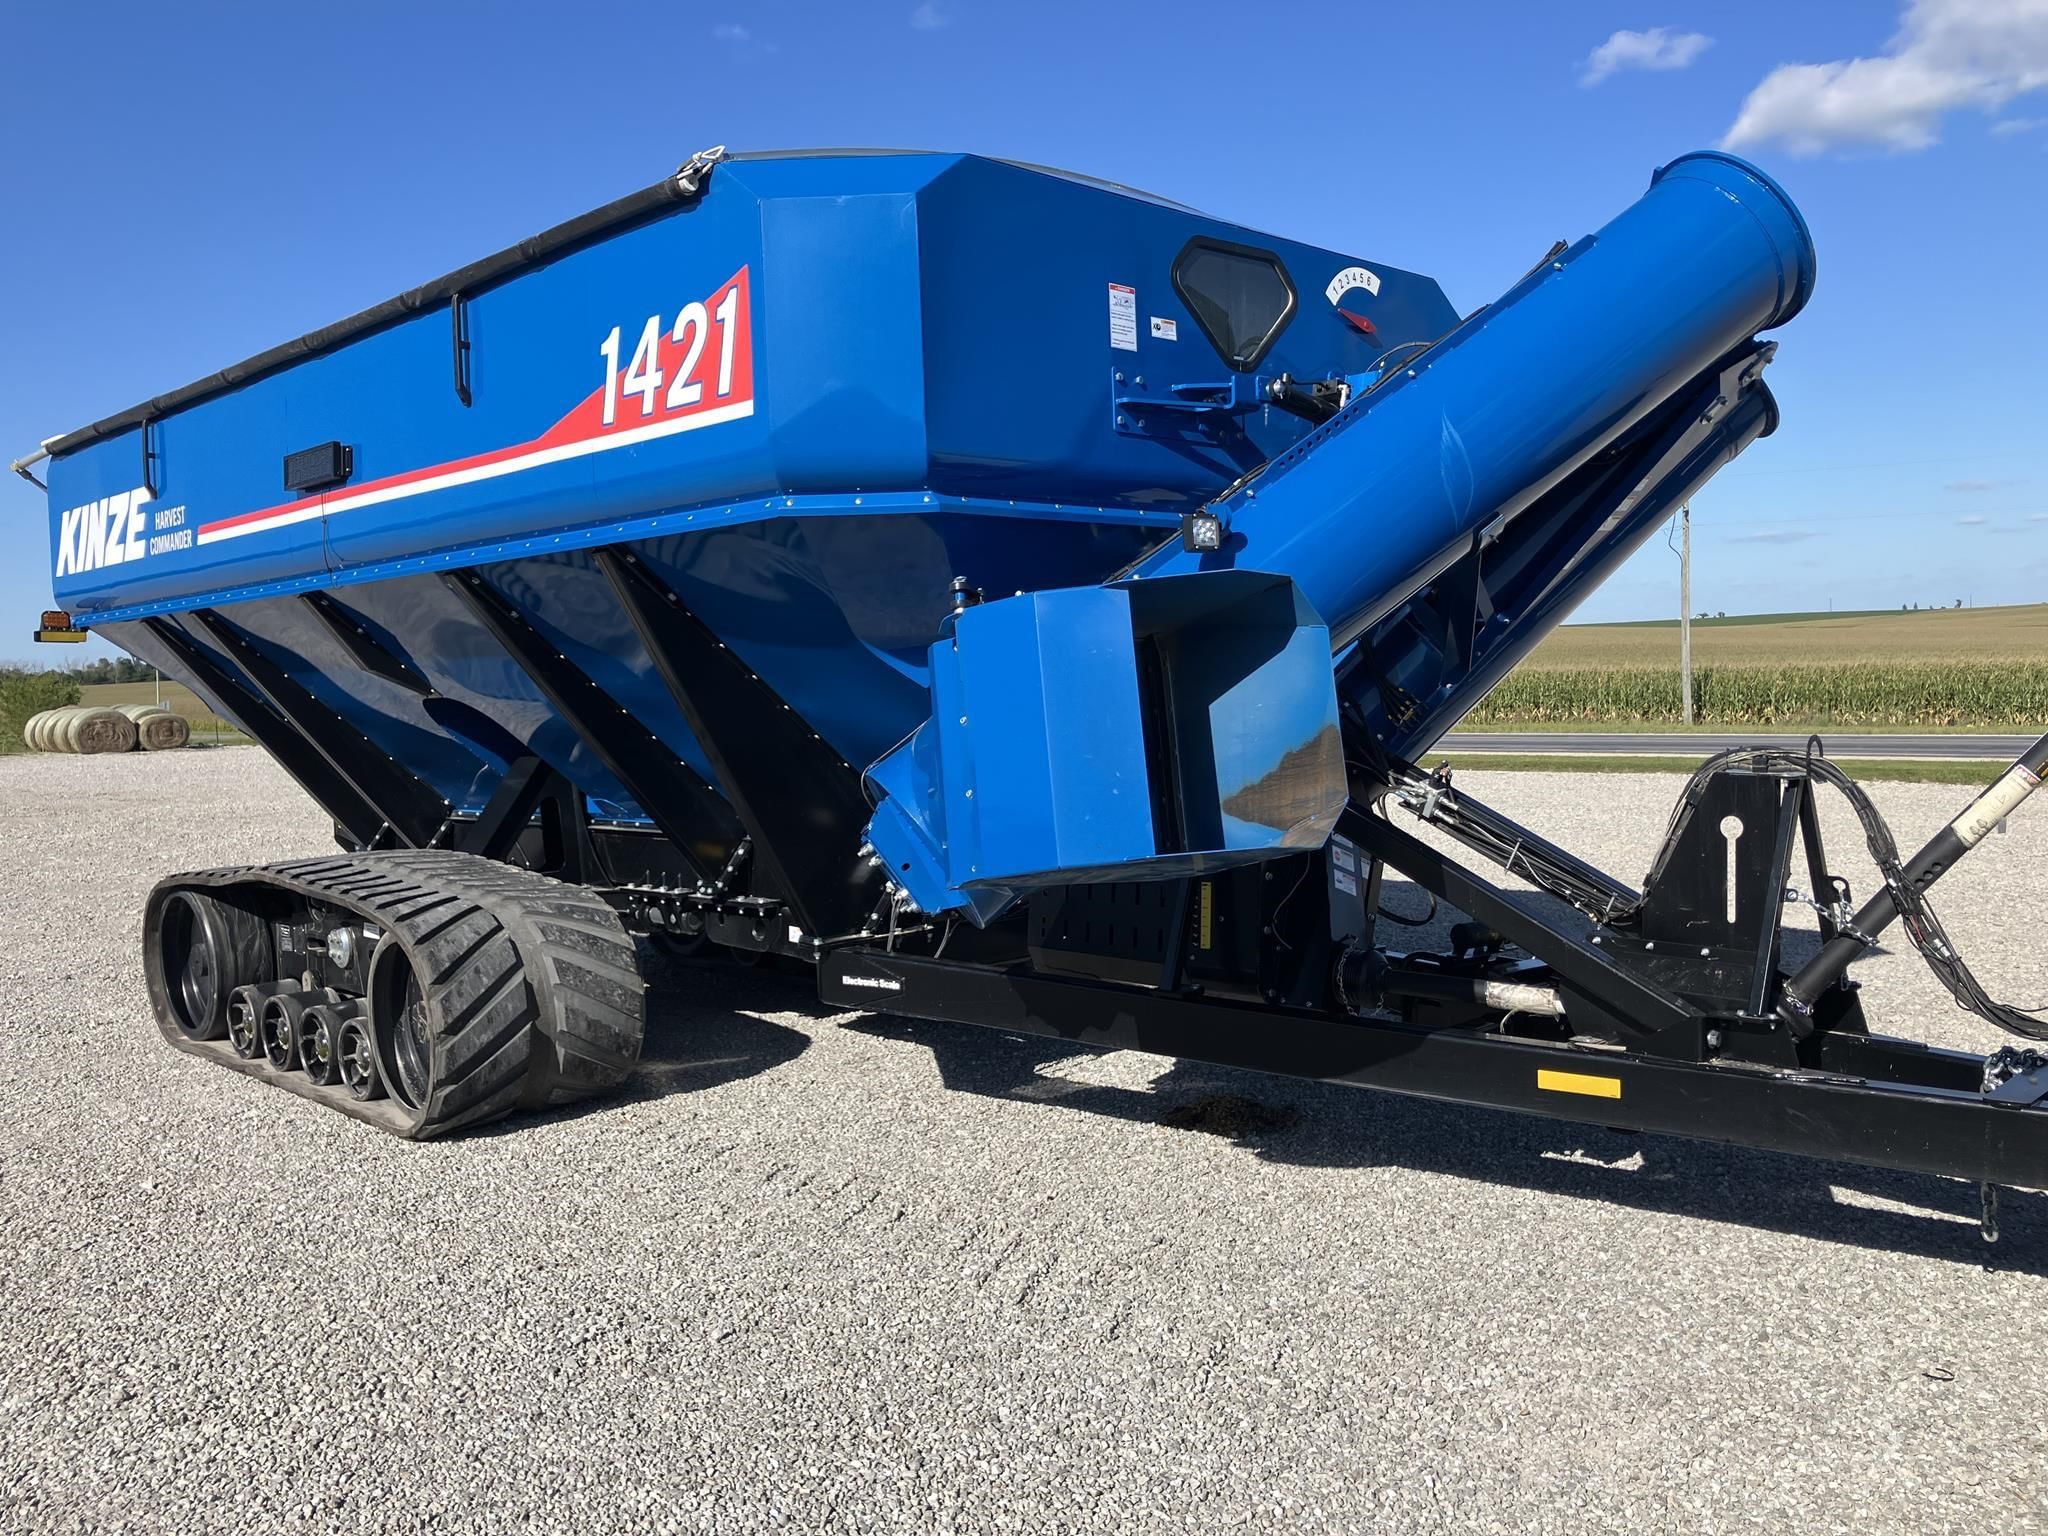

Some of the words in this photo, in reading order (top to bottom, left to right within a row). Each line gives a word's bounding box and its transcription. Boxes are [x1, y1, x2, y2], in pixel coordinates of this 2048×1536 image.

[1332, 285, 1339, 295] 1
[1338, 278, 1344, 290] 2
[1344, 273, 1350, 285] 3
[1352, 272, 1357, 282] 4
[1359, 272, 1364, 284] 5
[1366, 276, 1372, 287] 6
[600, 287, 738, 424] 1421
[155, 505, 186, 530] HARVEST
[56, 486, 152, 577] KINZE
[149, 529, 193, 556] COMMANDER
[842, 975, 879, 988] Electronic
[879, 978, 901, 990] Scale
